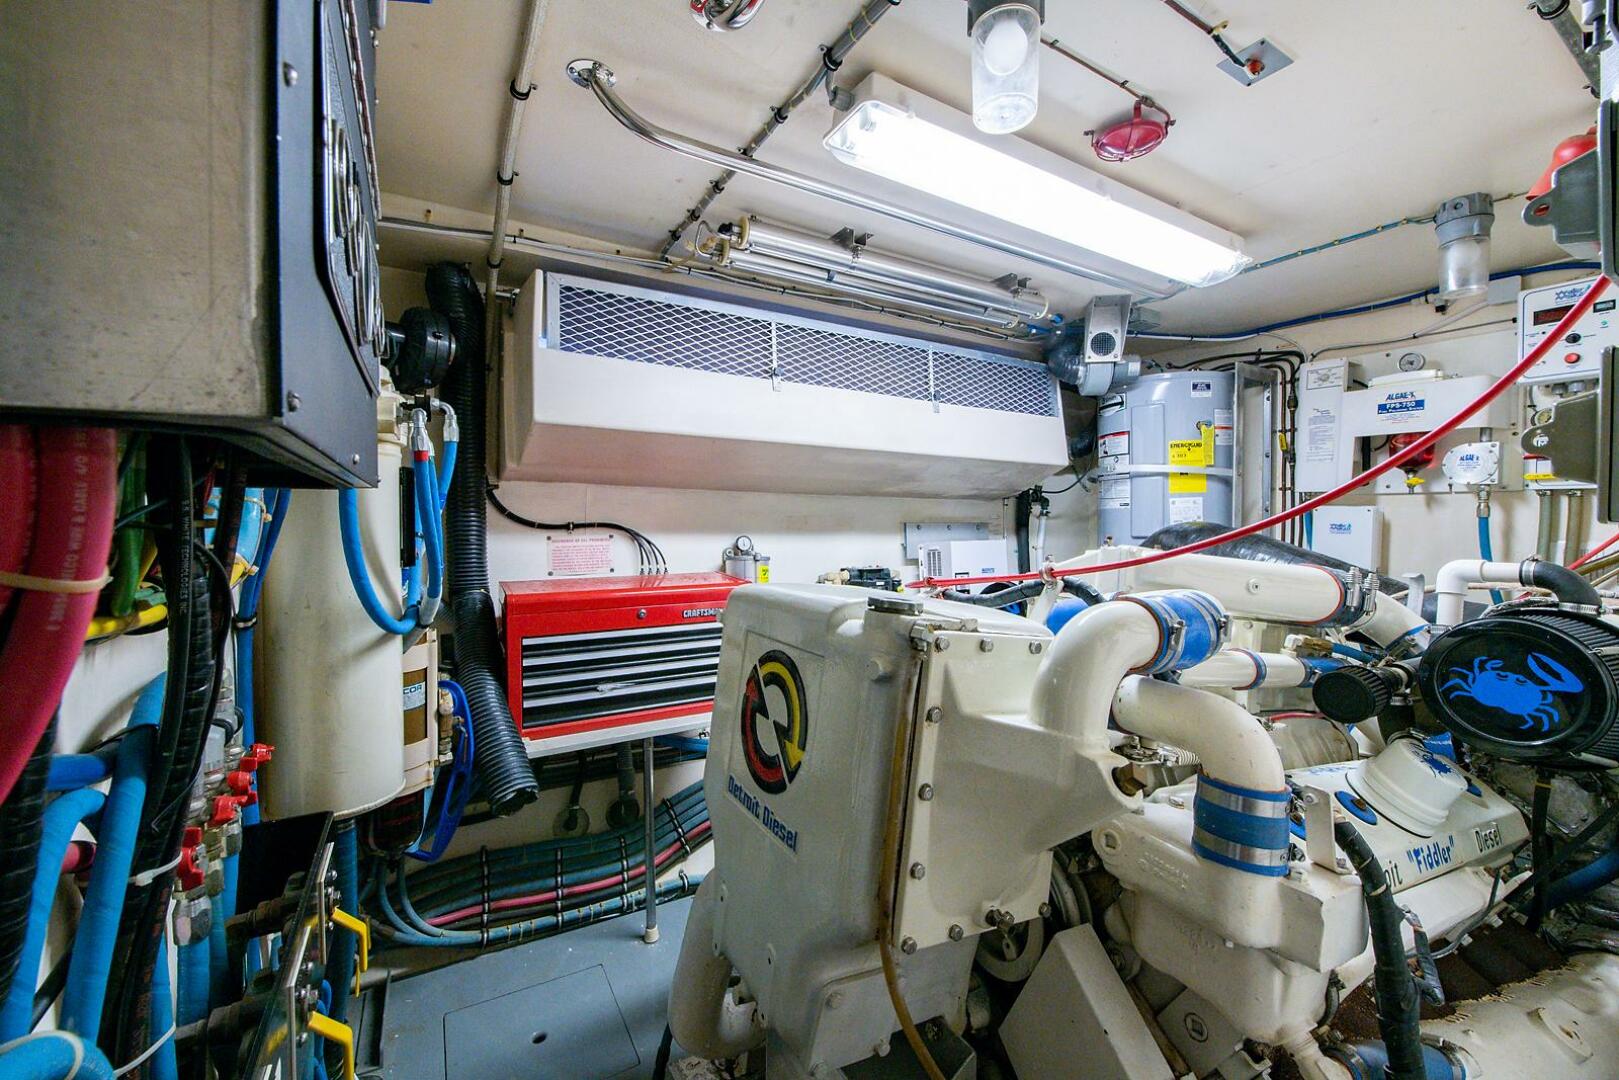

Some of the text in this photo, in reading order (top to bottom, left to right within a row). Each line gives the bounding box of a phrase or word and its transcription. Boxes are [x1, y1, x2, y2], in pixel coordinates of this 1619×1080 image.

[1386, 391, 1416, 401] ALGAE-X
[728, 775, 798, 852] Detroit Diesel
[1474, 823, 1503, 853] Diesel
